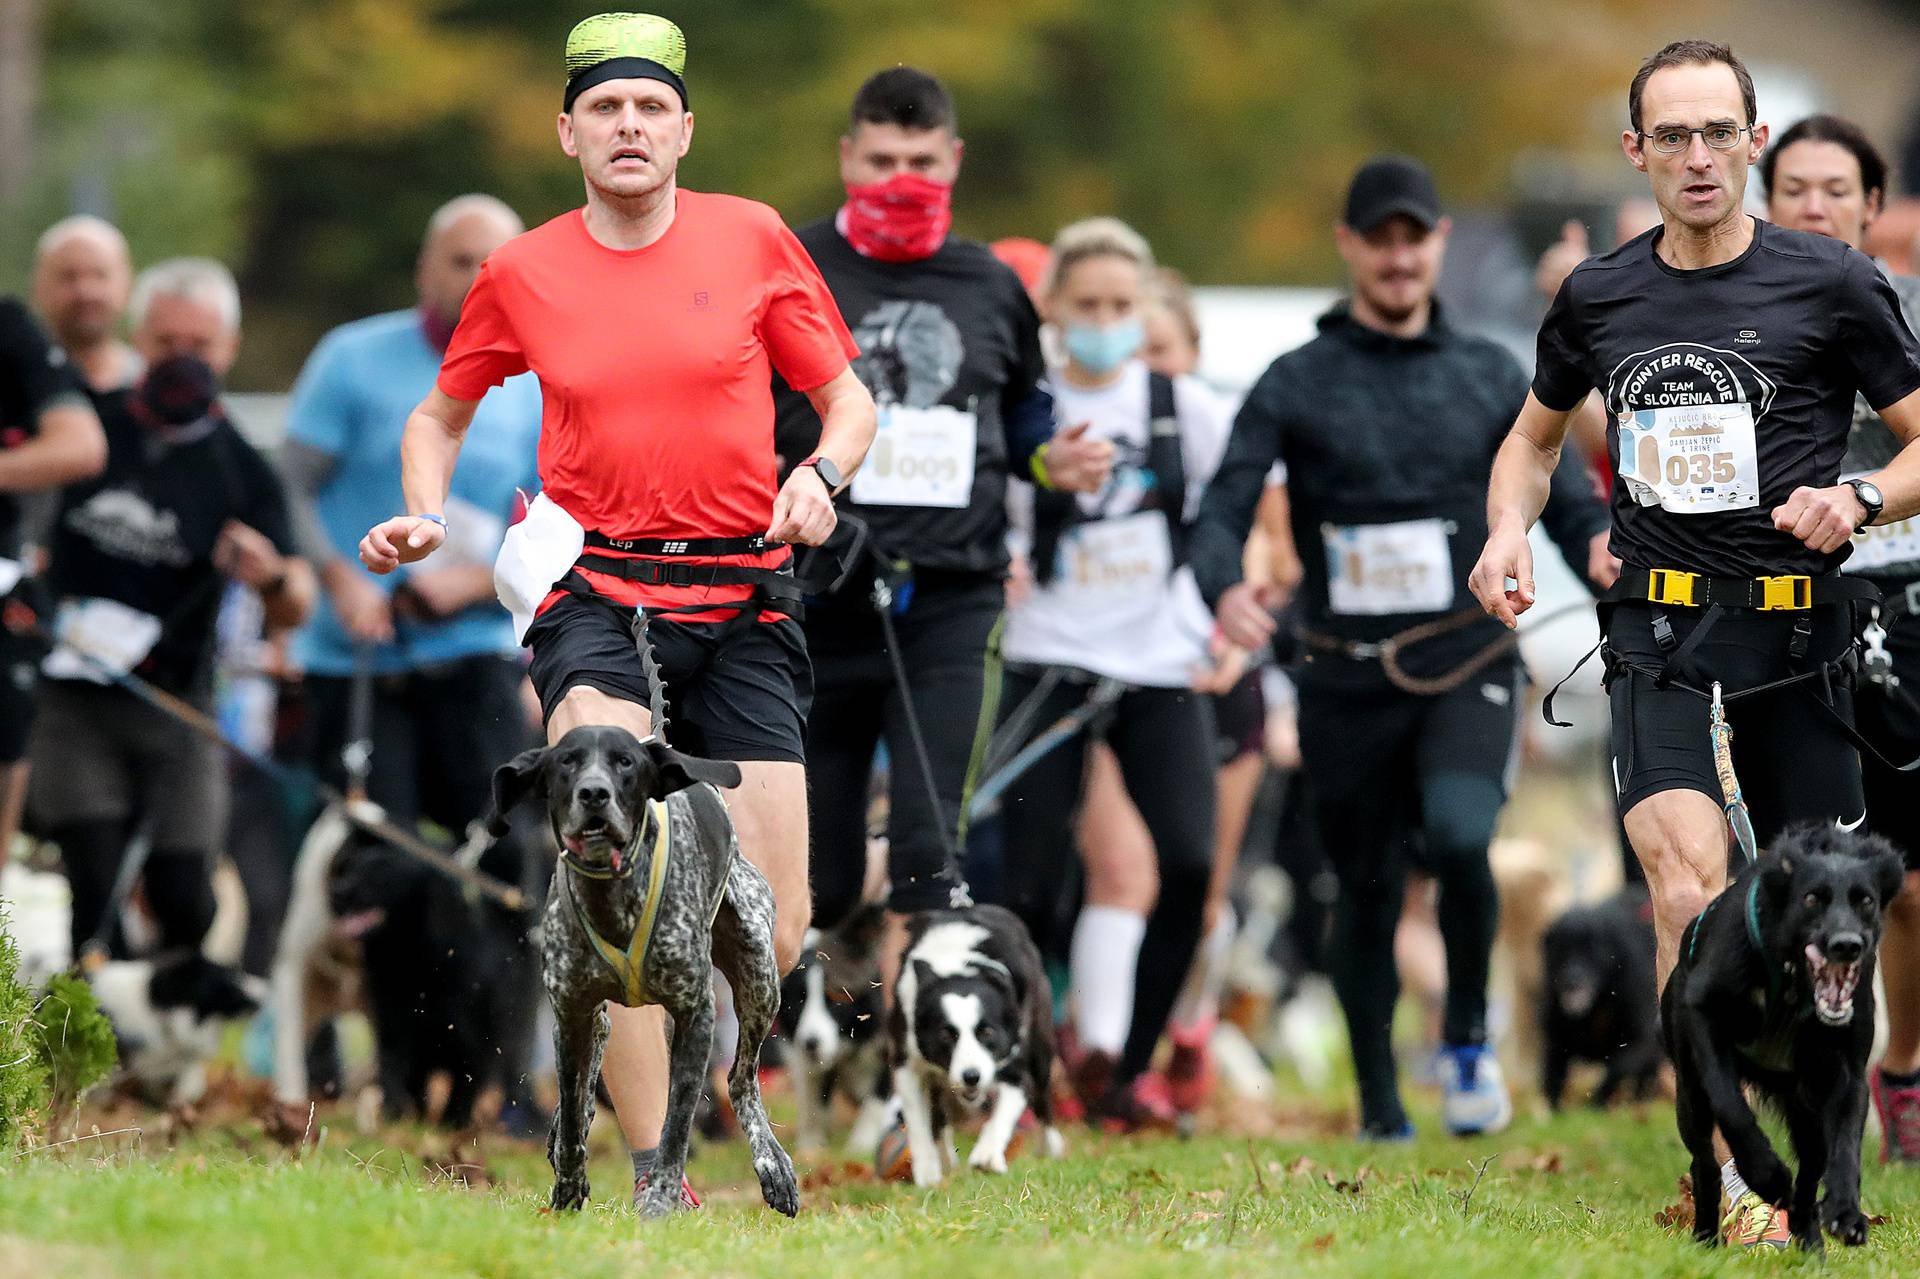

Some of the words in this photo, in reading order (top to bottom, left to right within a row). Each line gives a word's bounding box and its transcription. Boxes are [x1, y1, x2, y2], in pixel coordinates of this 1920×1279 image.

[1628, 353, 1681, 405] POINTER
[1684, 353, 1733, 403] RESCUE
[1662, 382, 1694, 391] TEAM
[1644, 392, 1714, 406] SLOVENIA
[1670, 438, 1698, 447] DAMJAN
[1690, 444, 1711, 452] TRINE
[1665, 452, 1736, 486] 035
